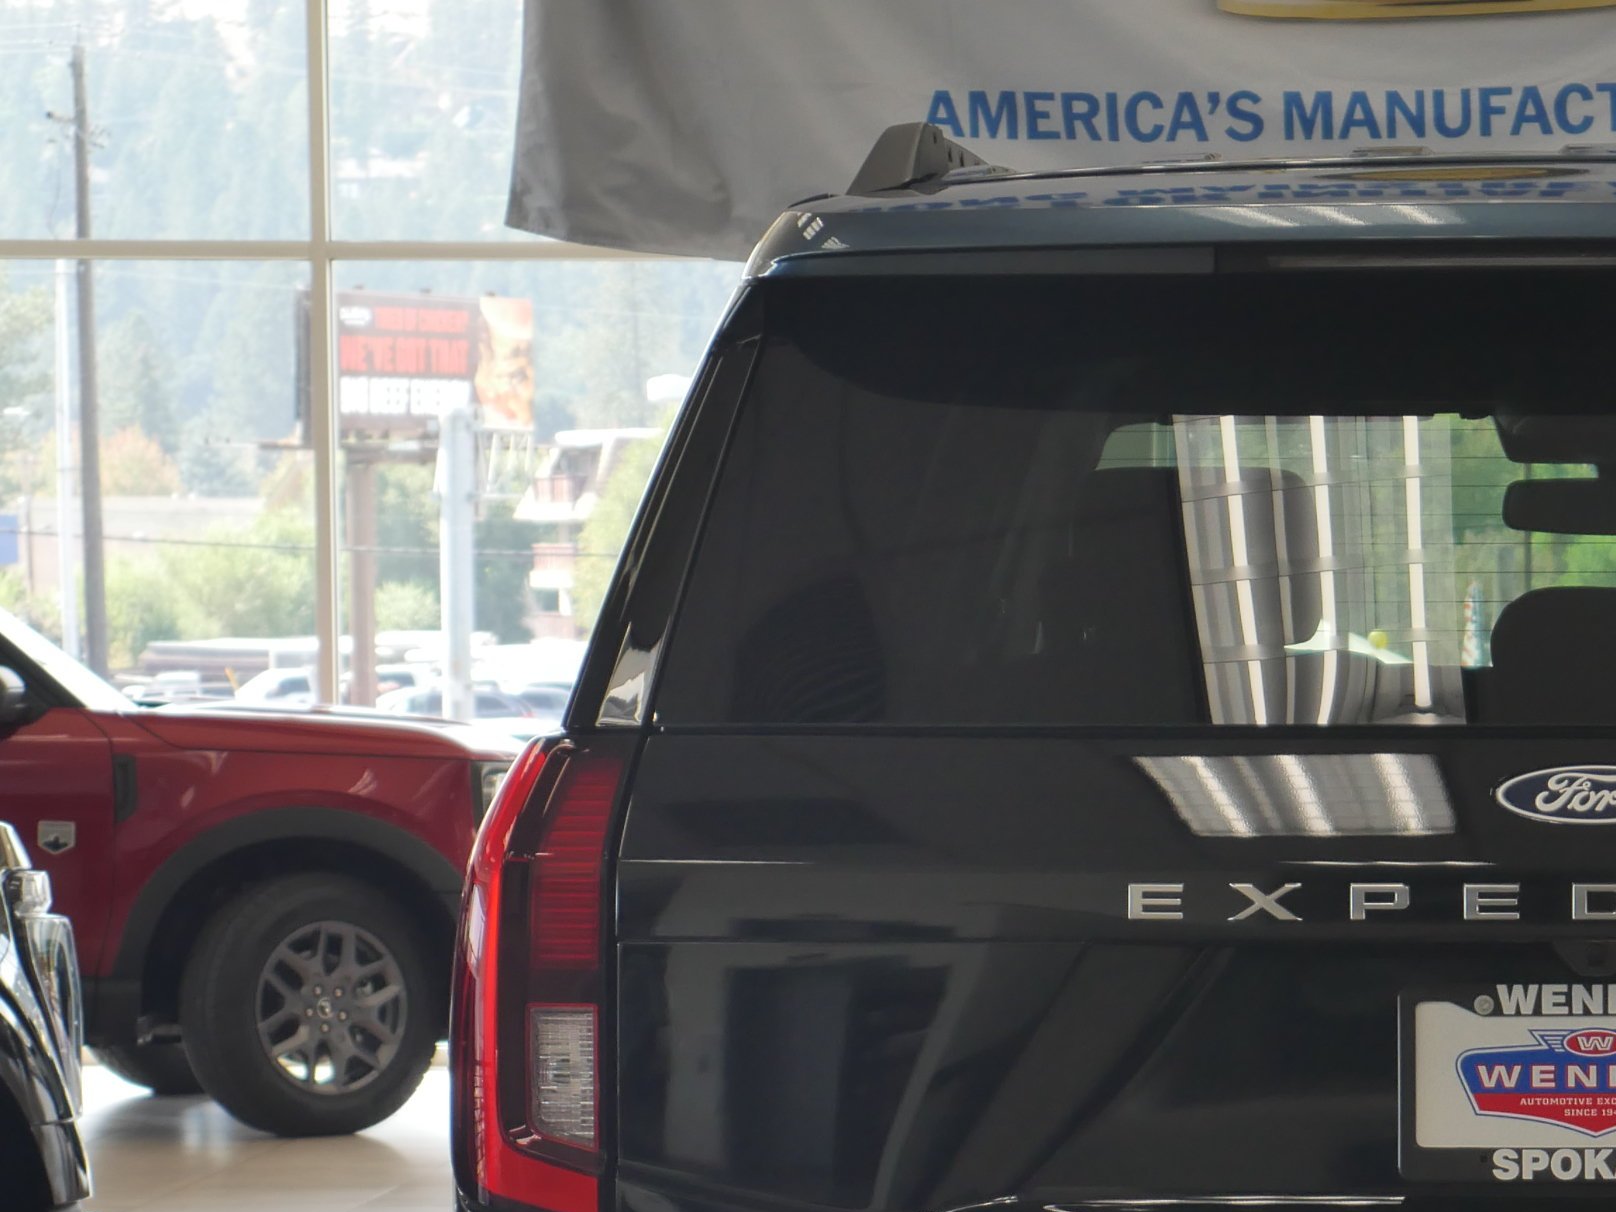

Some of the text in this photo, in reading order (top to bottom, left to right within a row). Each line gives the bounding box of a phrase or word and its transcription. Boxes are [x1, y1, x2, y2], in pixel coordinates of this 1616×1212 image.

[926, 90, 1264, 142] AMERICA'S
[1520, 1097, 1593, 1105] AUTOMOTIVE
[1564, 1108, 1597, 1117] SINCE
